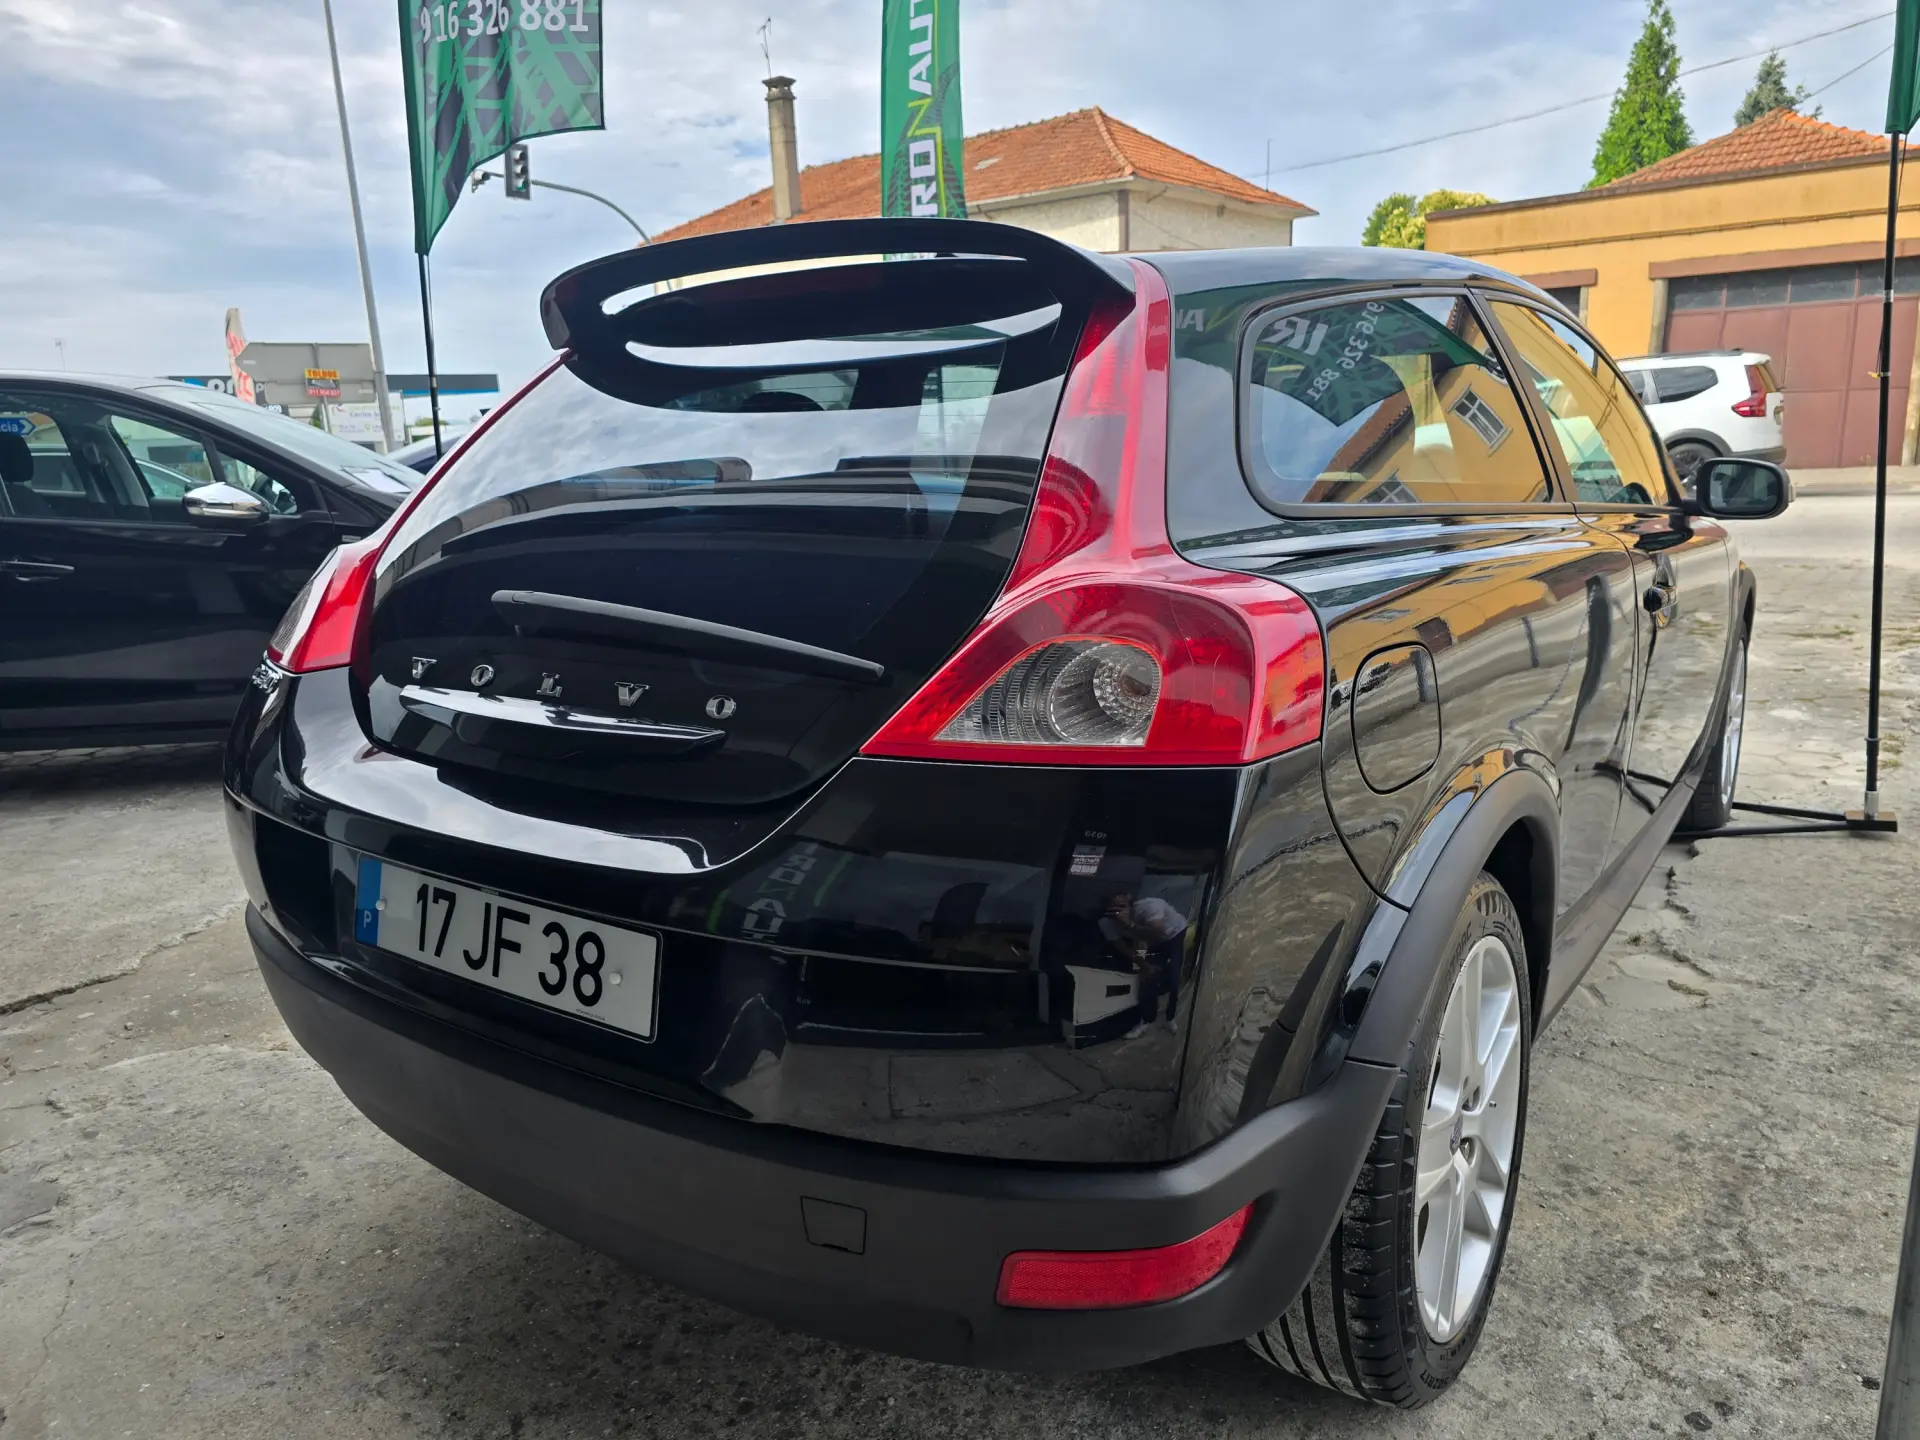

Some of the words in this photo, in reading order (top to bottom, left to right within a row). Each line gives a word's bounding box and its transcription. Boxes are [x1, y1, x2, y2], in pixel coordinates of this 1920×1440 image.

[420, 4, 460, 43] 916
[466, 0, 510, 37] 326
[519, 0, 589, 32] 881
[412, 656, 737, 719] VOLVO
[363, 910, 372, 928] P
[416, 883, 457, 958] 17
[463, 902, 531, 978] JF
[537, 921, 606, 1007] 38
